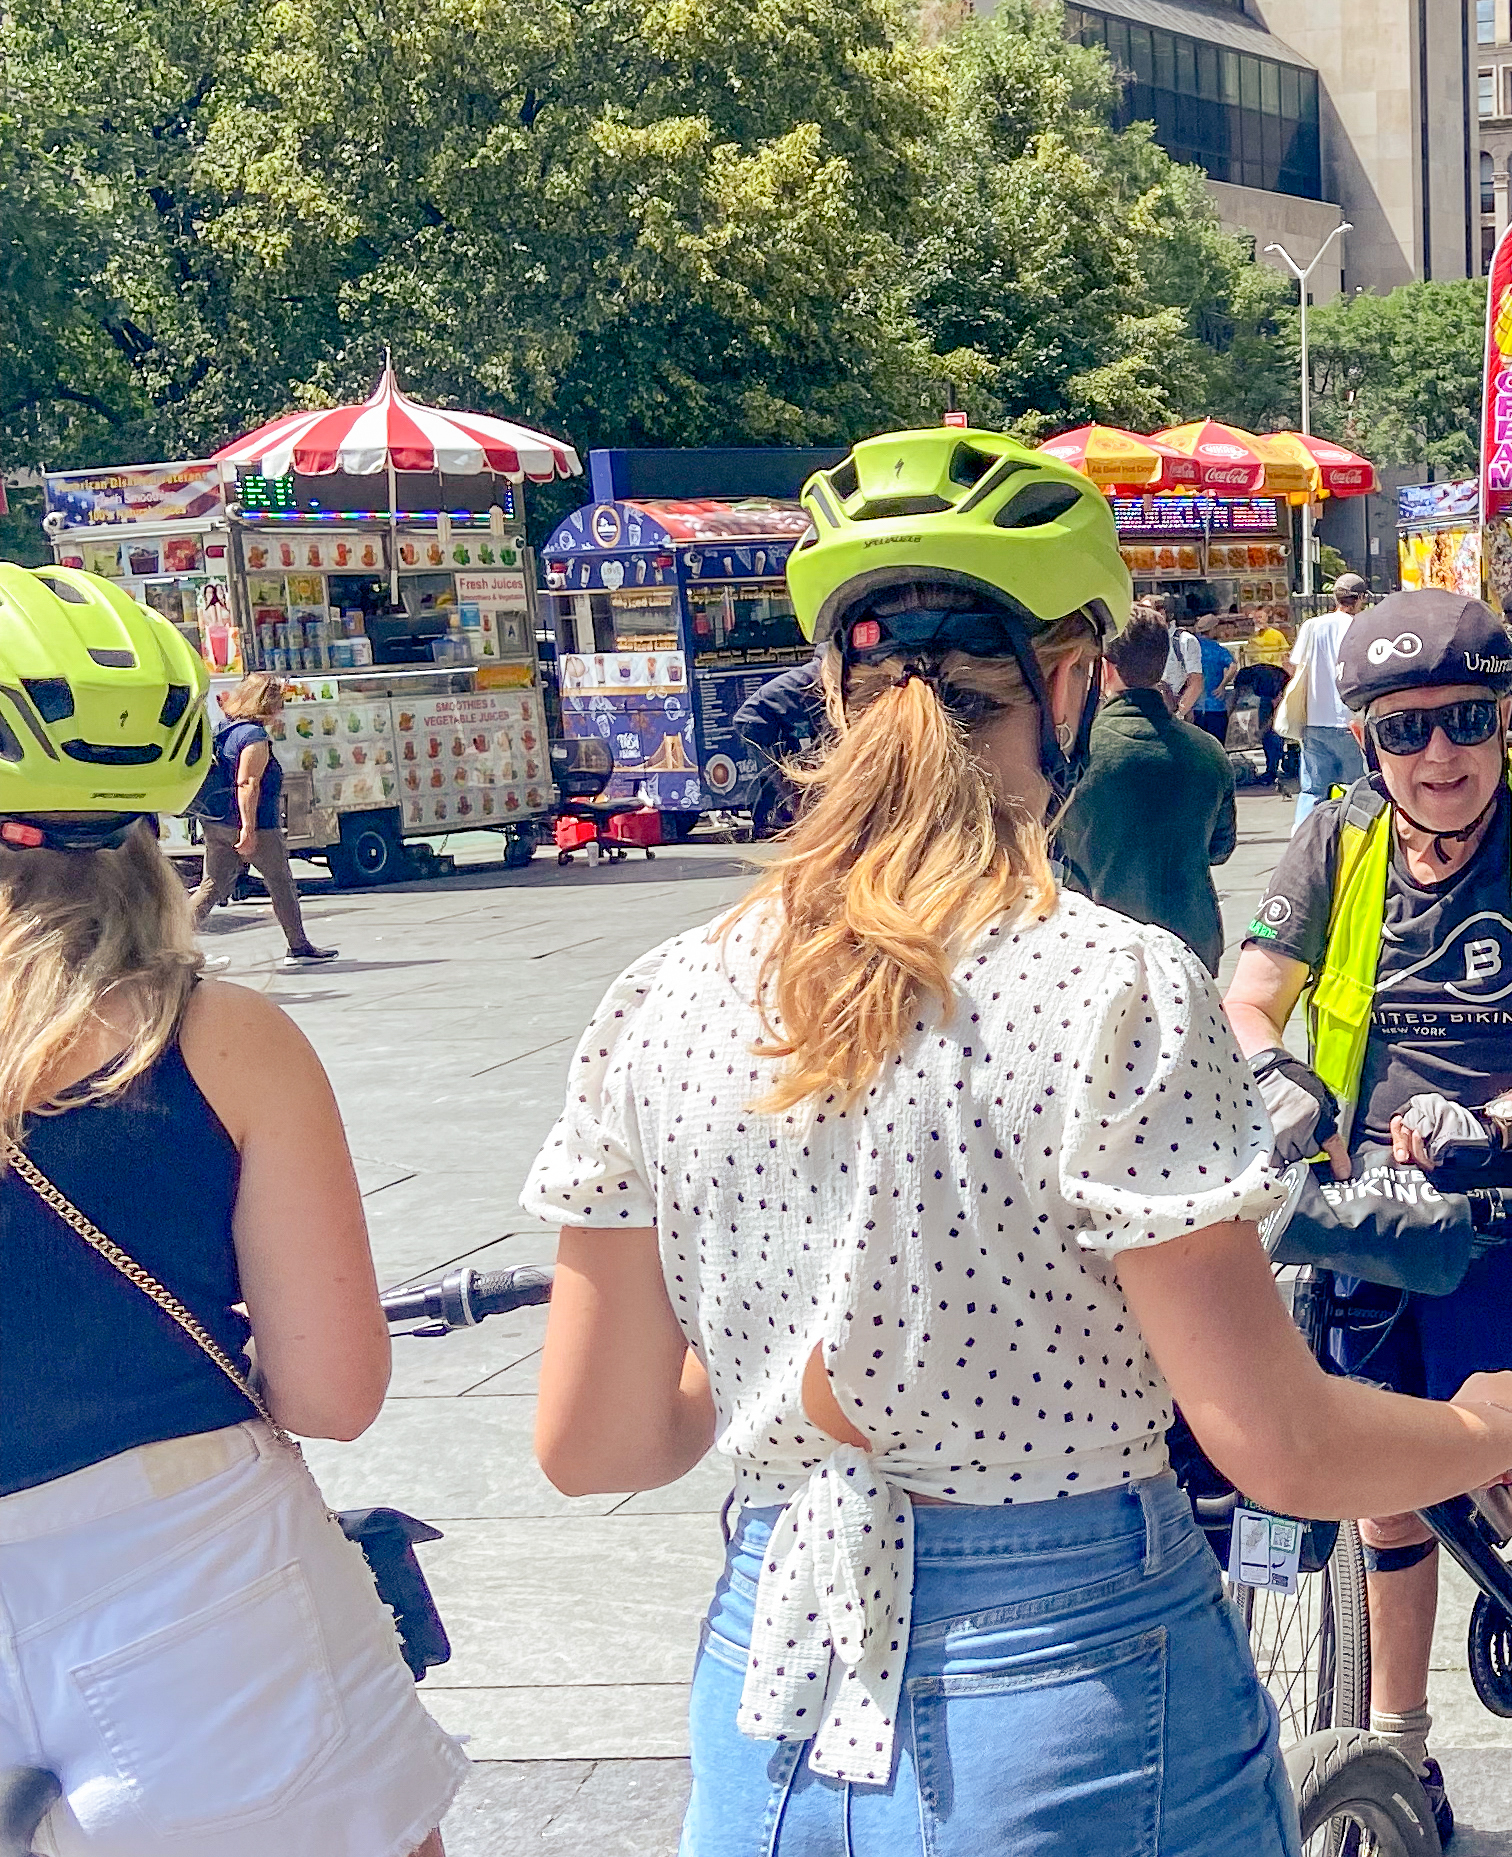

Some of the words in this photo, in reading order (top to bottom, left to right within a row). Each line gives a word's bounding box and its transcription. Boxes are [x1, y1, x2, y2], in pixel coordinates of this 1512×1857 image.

[459, 577, 489, 590] Fresh
[491, 577, 524, 590] Juices
[507, 624, 516, 638] A
[423, 713, 477, 727] VEGETABLE
[480, 711, 510, 722] JUICES
[1464, 938, 1502, 981] B
[1382, 1026, 1408, 1035] NEW
[1414, 1025, 1447, 1037] YORK
[1322, 1177, 1444, 1206] BIKING
